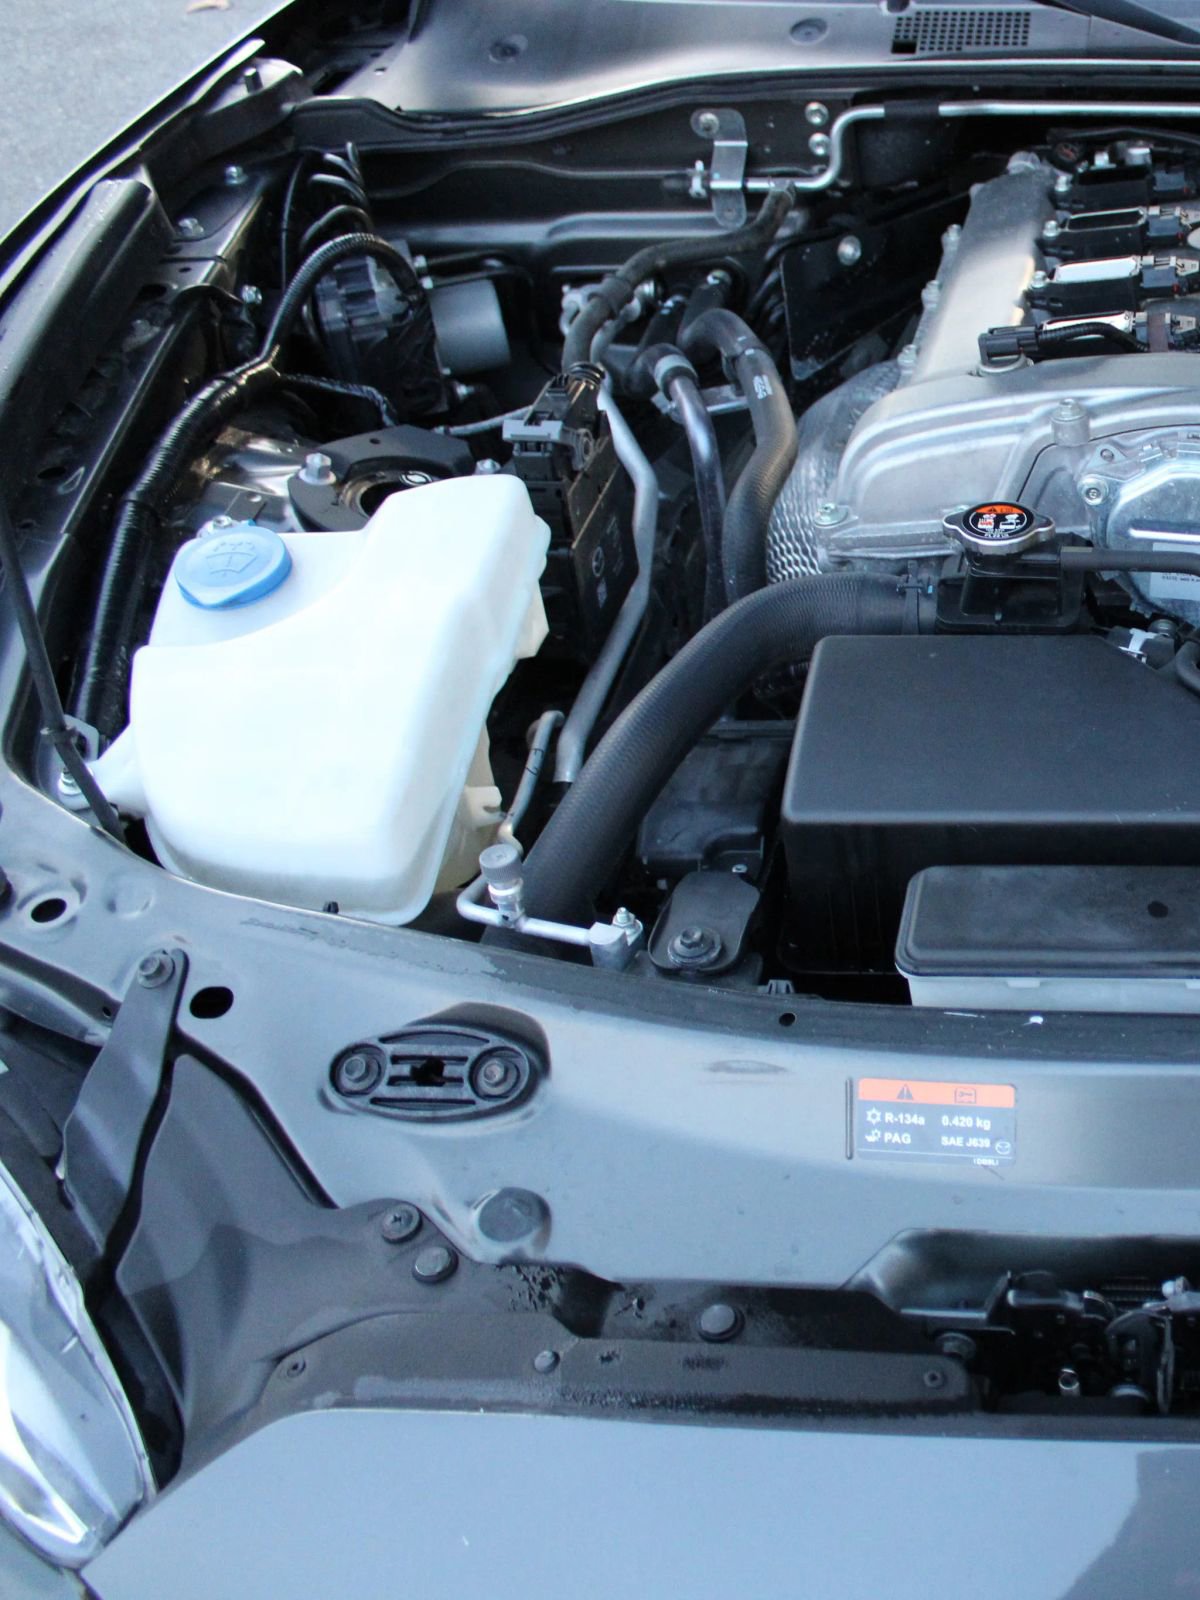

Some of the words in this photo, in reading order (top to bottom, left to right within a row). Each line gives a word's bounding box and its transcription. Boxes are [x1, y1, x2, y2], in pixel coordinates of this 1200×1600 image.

[884, 1111, 926, 1126] R-134a
[941, 1115, 974, 1127] 0.420
[976, 1116, 991, 1131] kg
[884, 1132, 912, 1145] PAG
[941, 1136, 964, 1147] SAE
